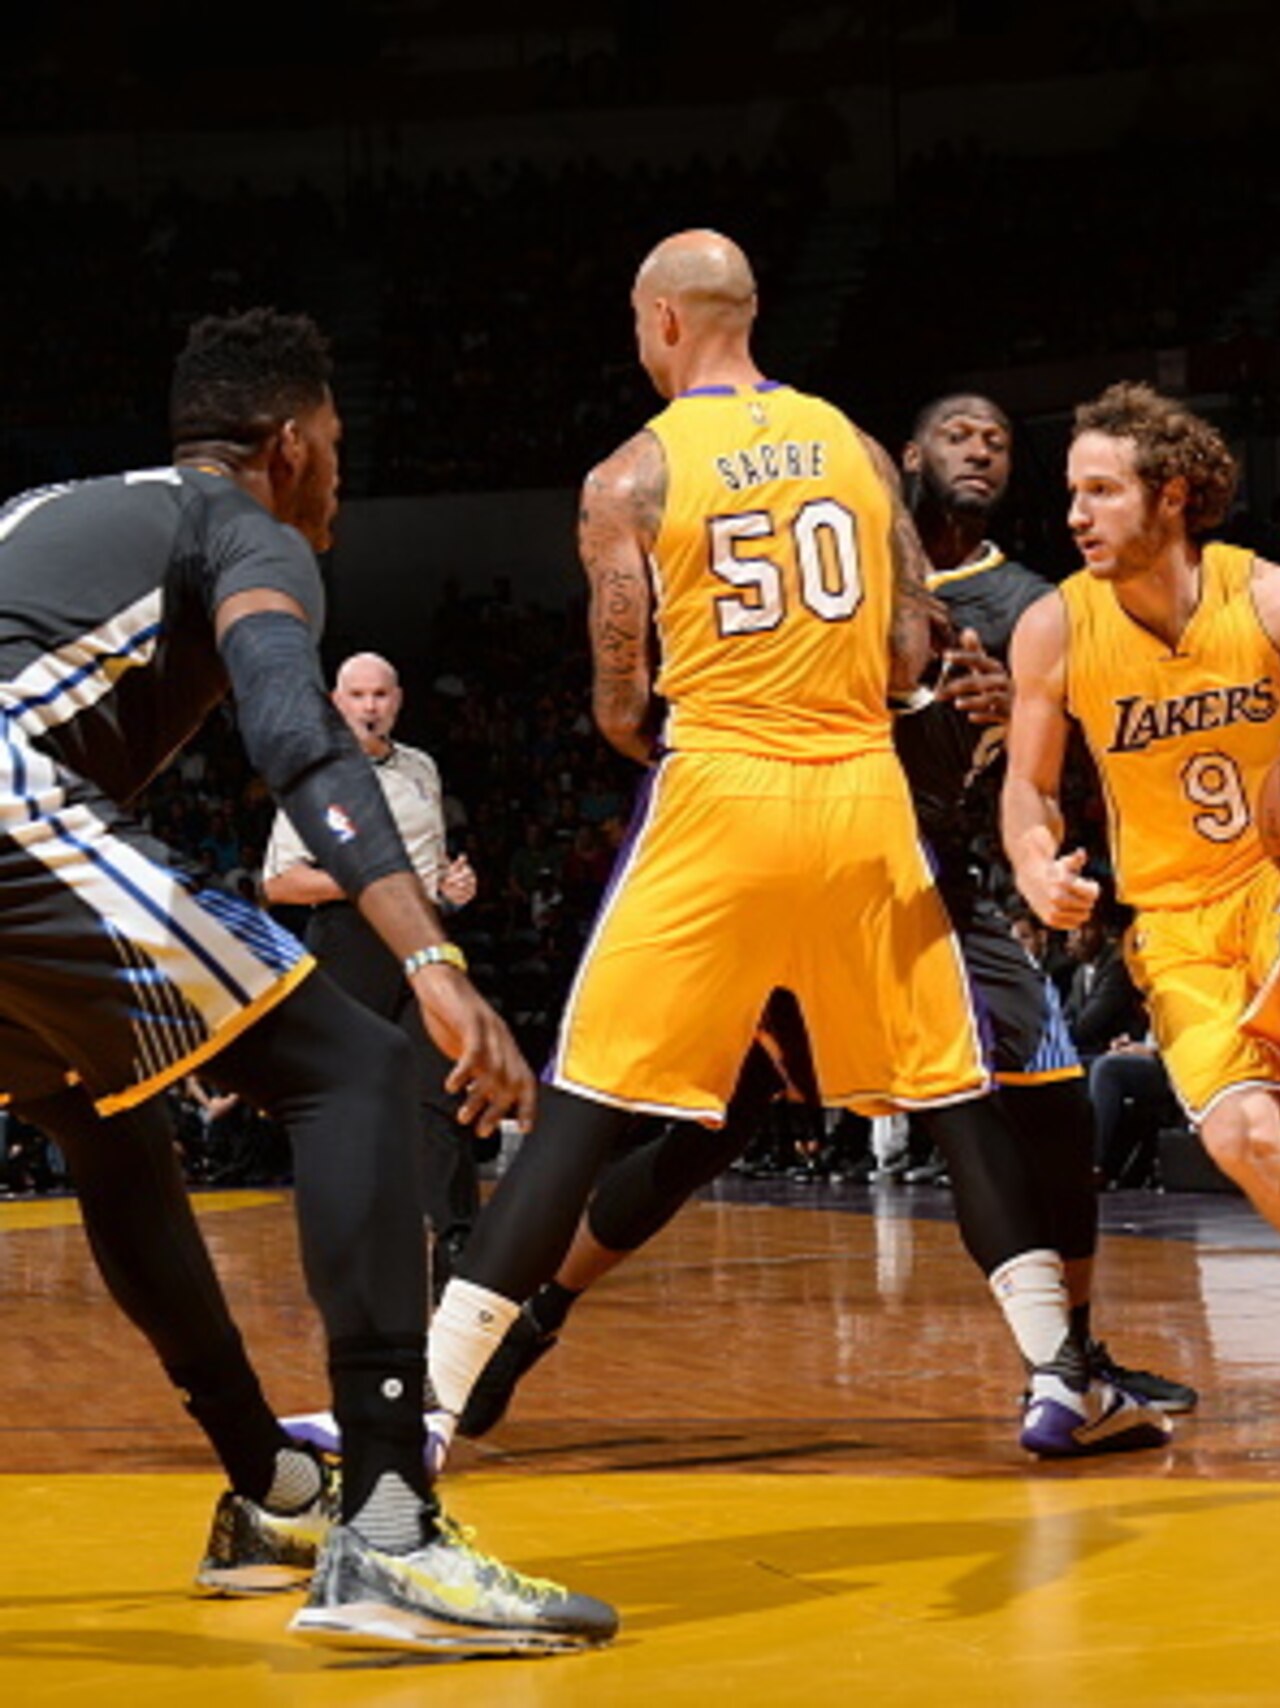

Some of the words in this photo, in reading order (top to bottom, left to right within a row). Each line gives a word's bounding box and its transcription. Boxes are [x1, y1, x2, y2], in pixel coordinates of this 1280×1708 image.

[706, 496, 865, 638] 50
[1107, 677, 1279, 753] LAKERS
[1180, 750, 1250, 843] 9
